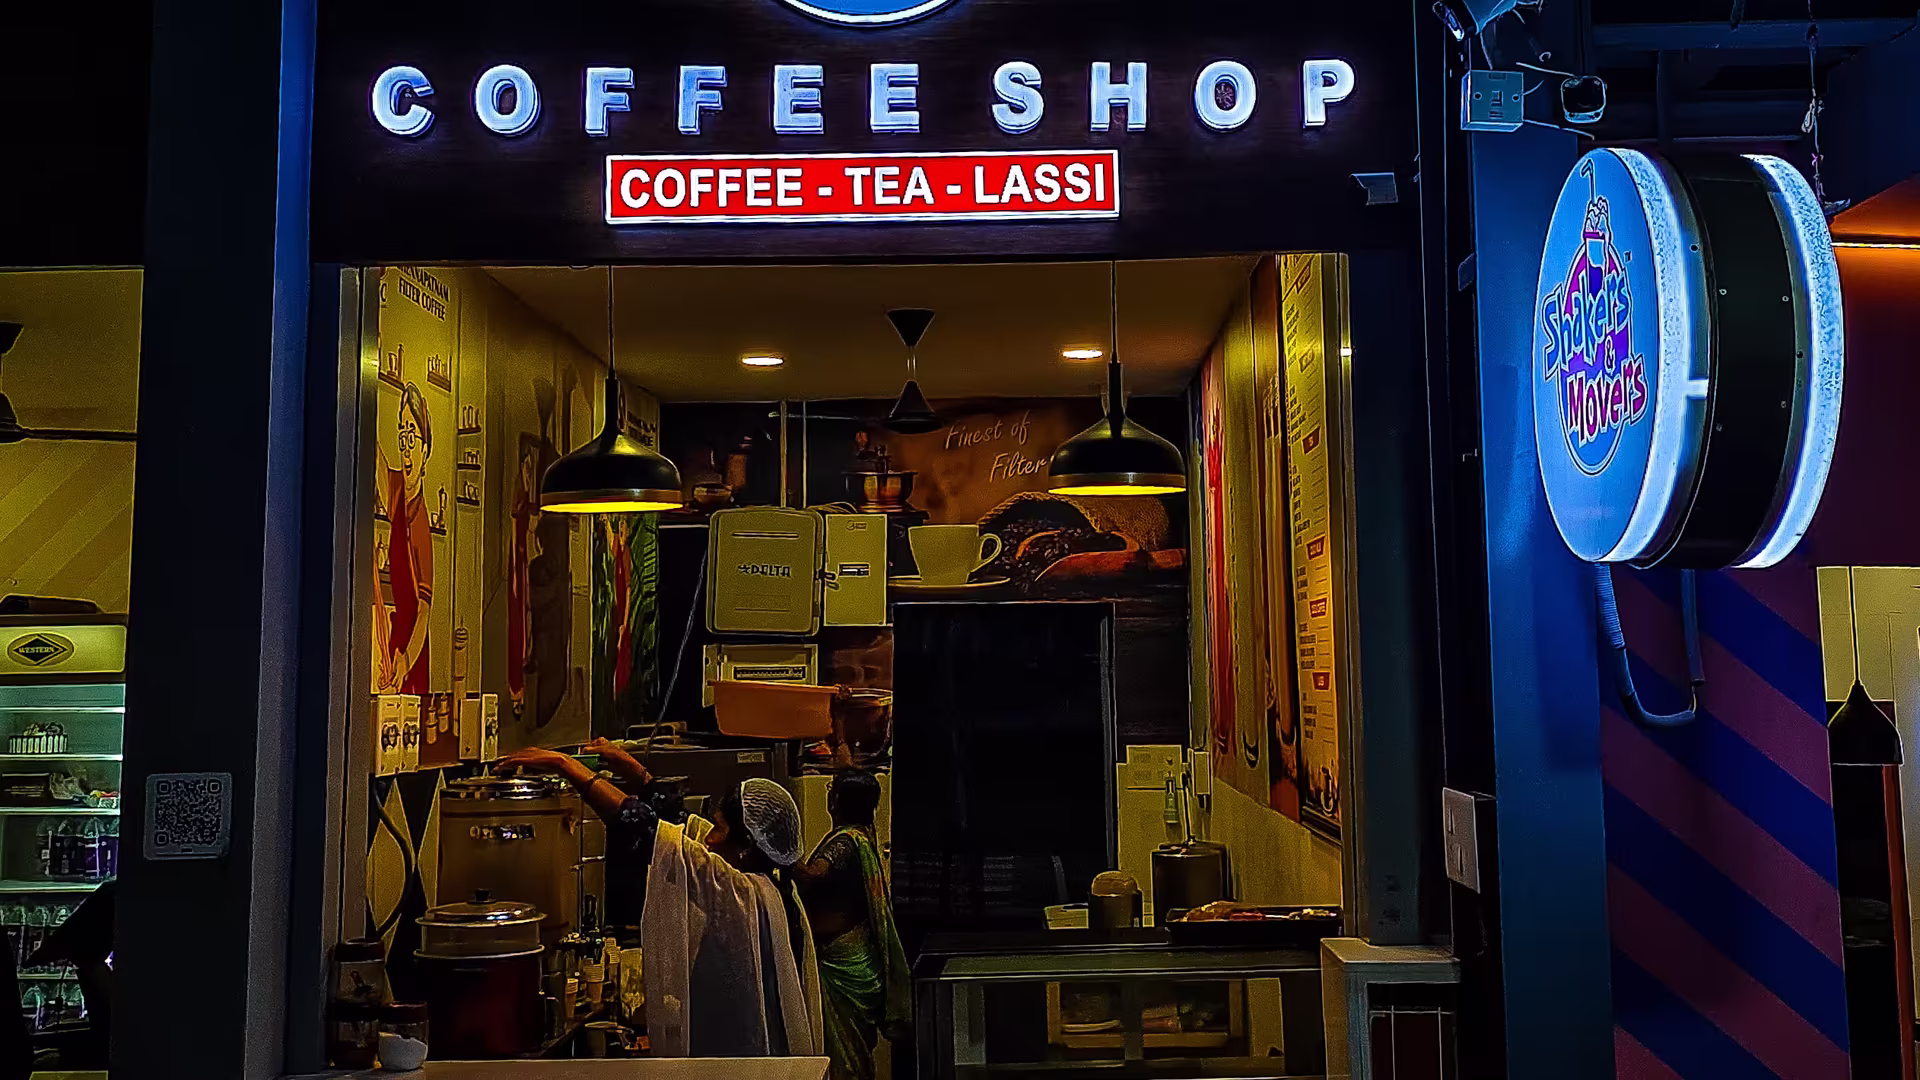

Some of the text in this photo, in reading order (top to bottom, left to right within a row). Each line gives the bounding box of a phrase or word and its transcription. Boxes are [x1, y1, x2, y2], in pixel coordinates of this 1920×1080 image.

[371, 59, 1356, 136] COFFEE SHOP
[620, 167, 803, 208] COFFEE
[844, 166, 935, 205] TEA
[974, 161, 1107, 204] LASSI
[400, 278, 420, 304] FILTER
[421, 292, 445, 320] COFFEE
[1543, 269, 1630, 379] Shakers
[1568, 357, 1647, 445] Movers
[945, 409, 1030, 449] Finest of
[988, 451, 1047, 483] Filter
